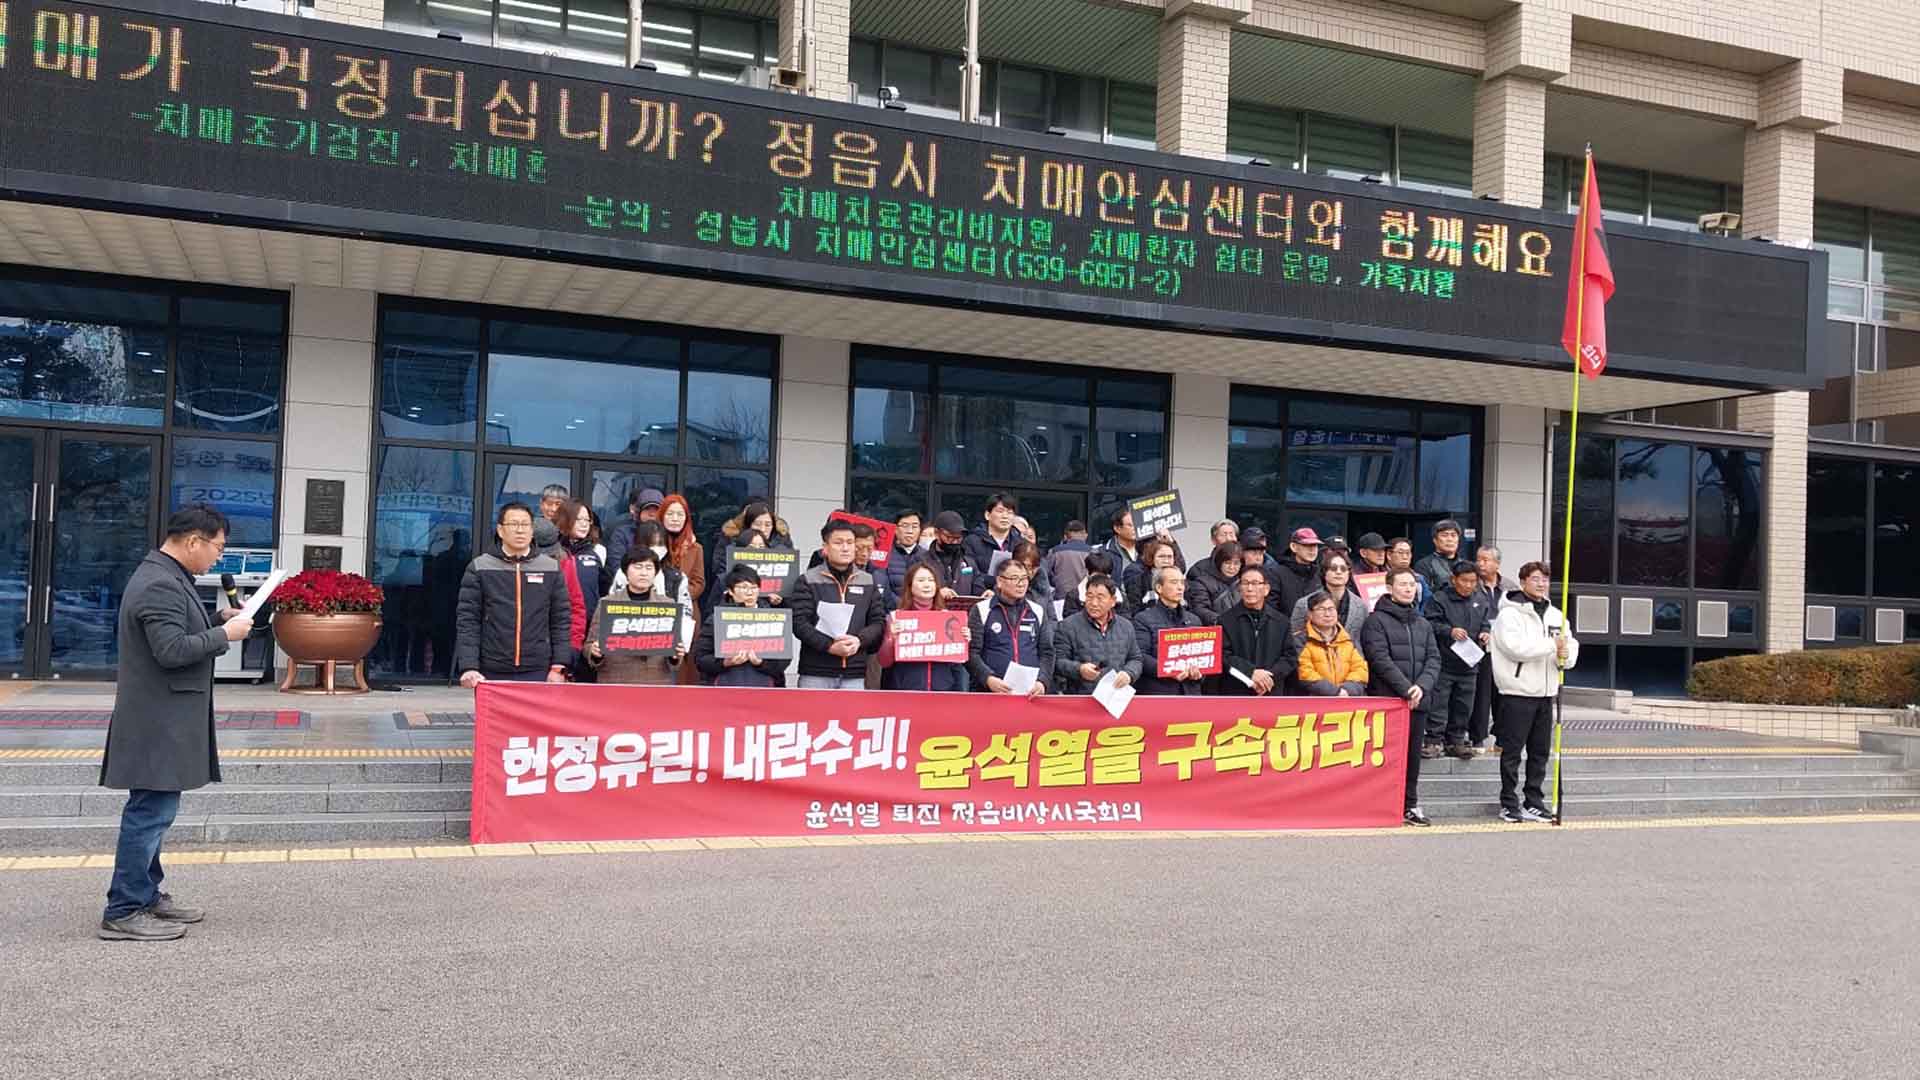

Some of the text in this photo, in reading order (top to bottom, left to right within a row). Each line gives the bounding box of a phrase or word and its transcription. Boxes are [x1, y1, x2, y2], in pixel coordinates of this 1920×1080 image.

[0, 2, 1552, 277] 매가 걱정되십니까? 정읍시 치매안심센터와 함께해요
[1360, 262, 1456, 299] 가족지원
[502, 709, 1386, 796] 헌정유린! 내란수괴! 윤석열을 구속하라!
[804, 799, 1142, 829] 윤석열 퇴진 정읍비상시국회의
